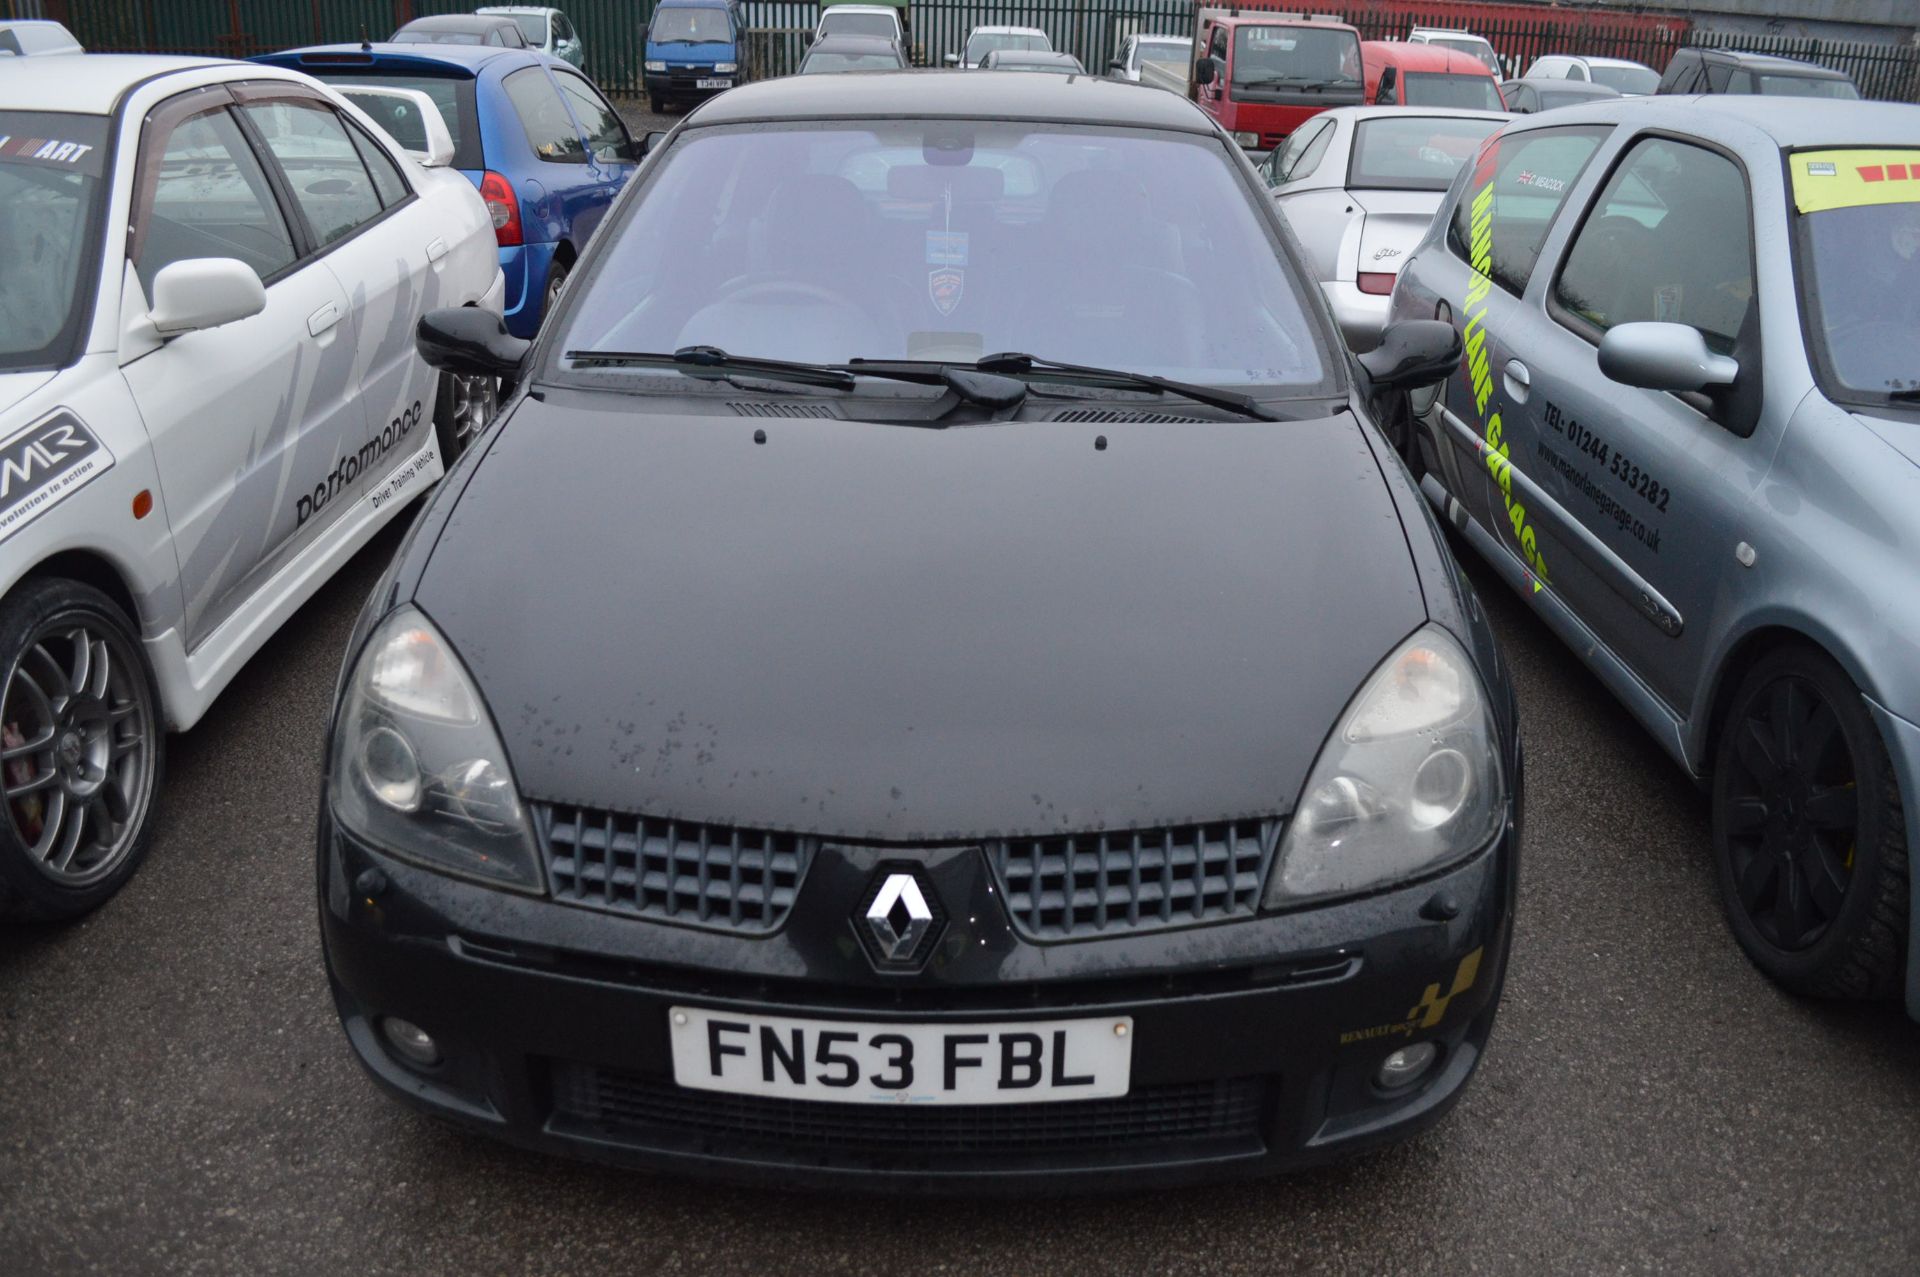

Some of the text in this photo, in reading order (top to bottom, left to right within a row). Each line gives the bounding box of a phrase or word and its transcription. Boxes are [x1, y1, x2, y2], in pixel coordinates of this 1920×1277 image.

[1464, 181, 1494, 316] MANOR
[1464, 307, 1494, 417] LANE
[49, 482, 62, 495] in
[62, 461, 94, 486] action
[372, 450, 434, 508] Driver Training Vehicle
[1538, 441, 1662, 555] www.manorlanegarage.co.uk
[1544, 401, 1670, 514] TEL: 01244 533282
[707, 1019, 1095, 1090] FN53 FBL
